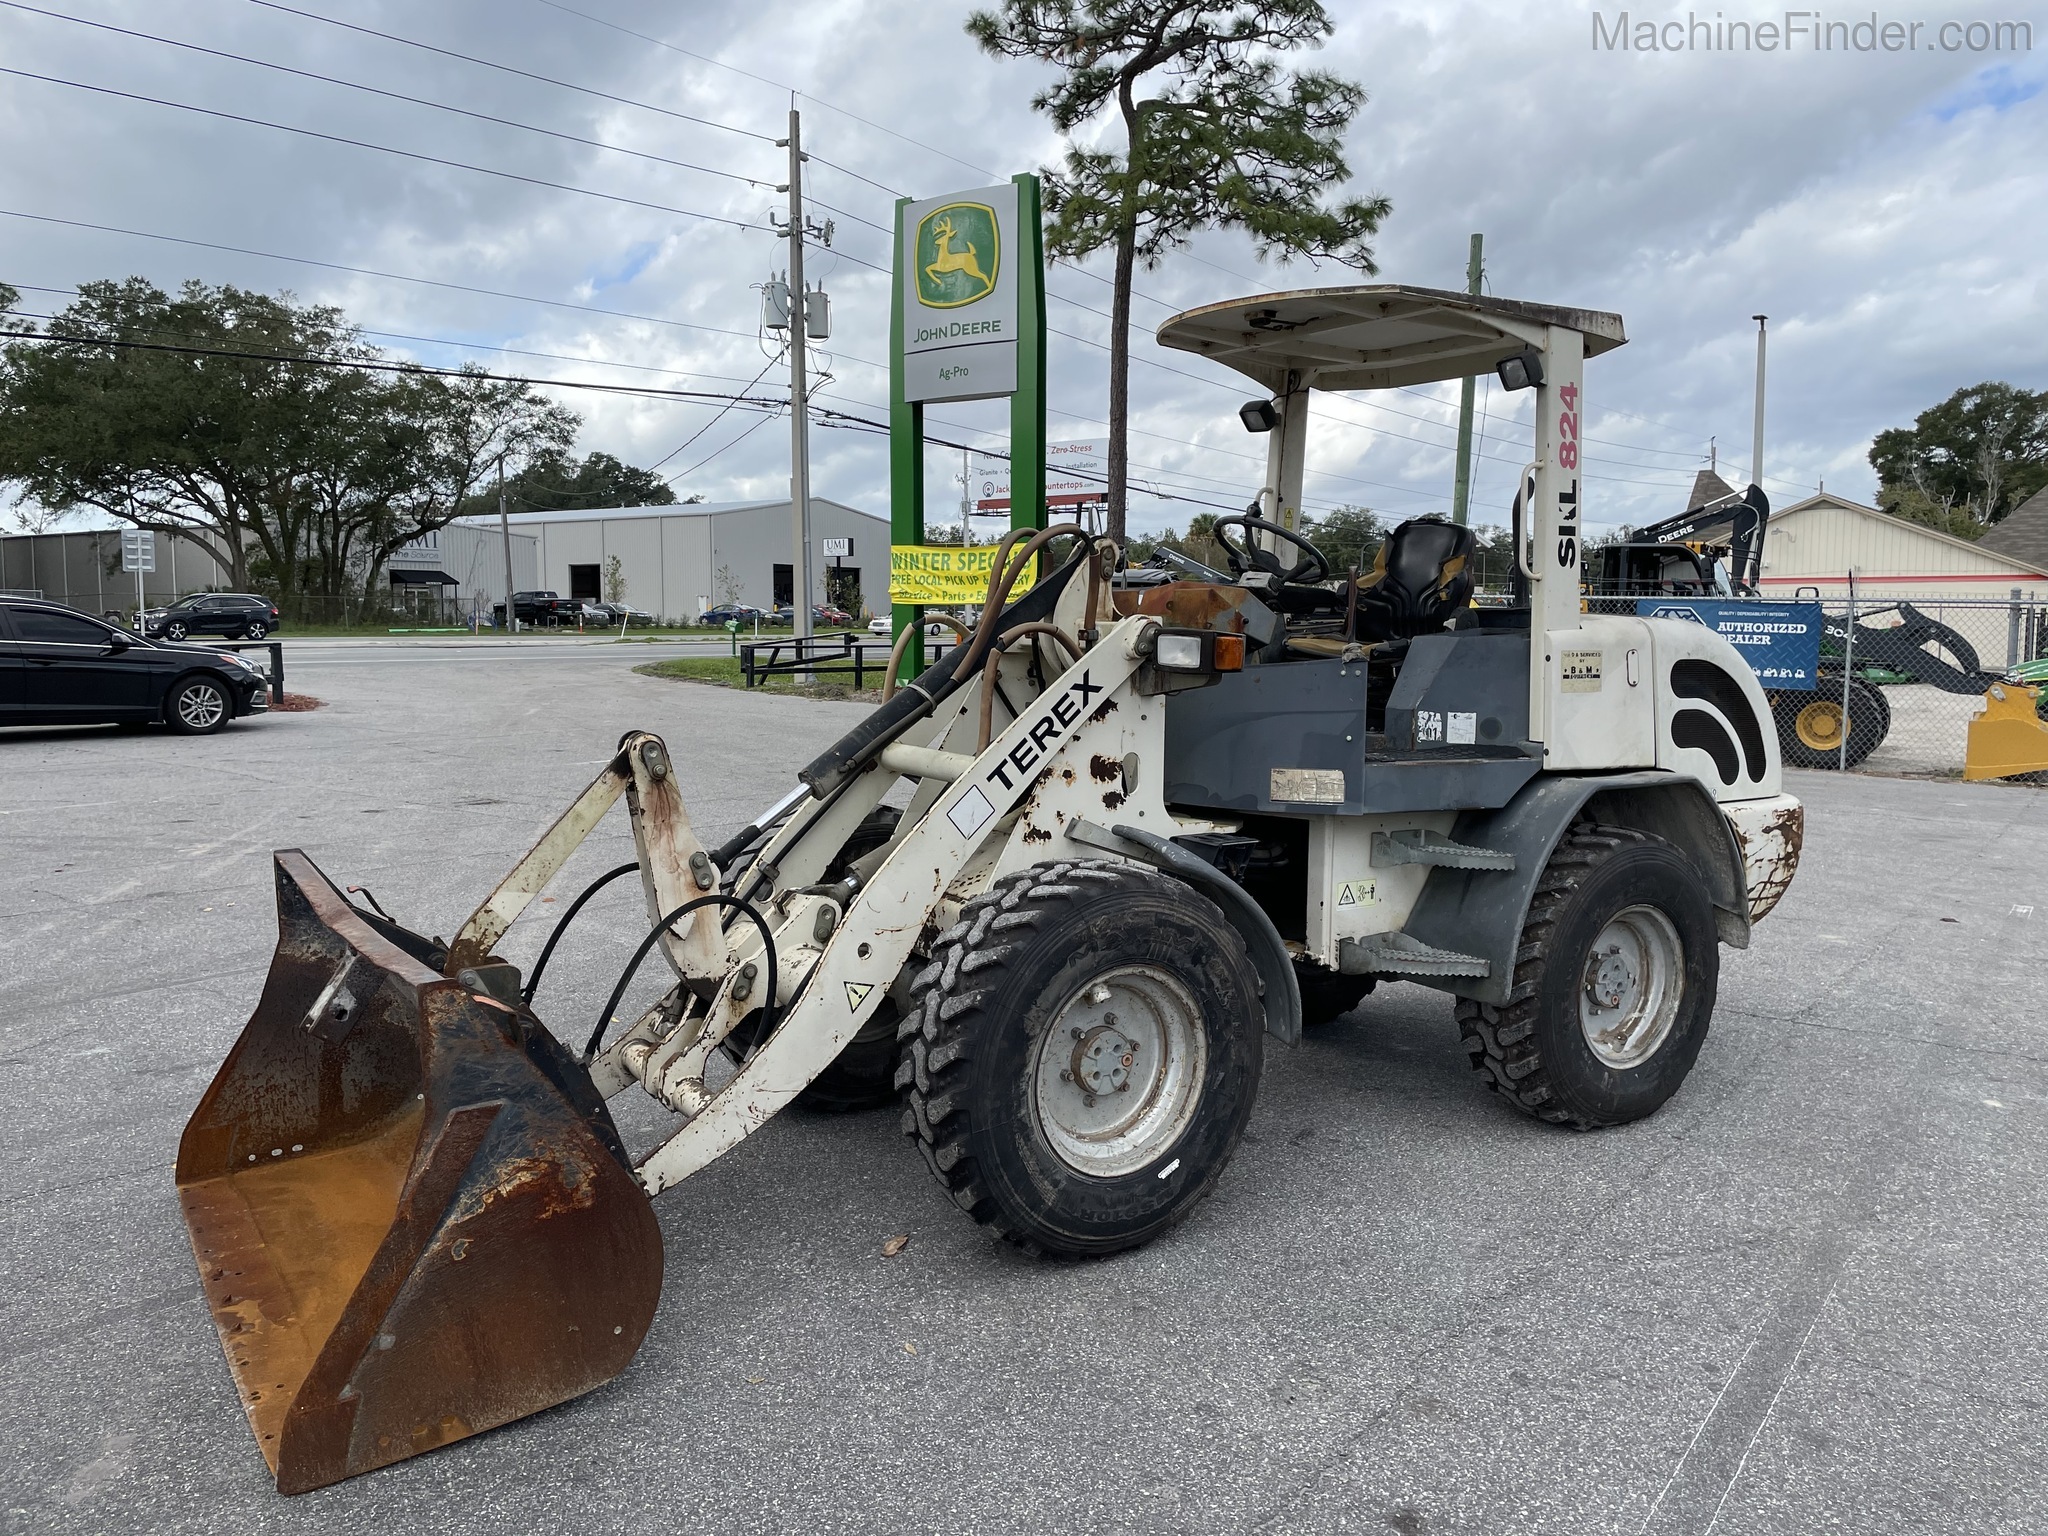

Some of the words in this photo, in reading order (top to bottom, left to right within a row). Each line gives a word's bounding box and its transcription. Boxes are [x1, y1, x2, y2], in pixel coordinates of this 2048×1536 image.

[913, 325, 948, 343] JOHN
[950, 319, 1002, 335] DEERE
[938, 366, 969, 381] Ag-Pro
[1559, 381, 1578, 471] 824
[1051, 446, 1068, 454] Zero
[1069, 444, 1092, 453] Stress
[979, 469, 998, 477] Granite
[1658, 524, 1695, 544] DEERE
[827, 539, 845, 549] UMI
[394, 550, 409, 558] The
[410, 551, 439, 559] Source
[891, 552, 951, 571] WINTER
[957, 552, 1031, 573] SPECA
[891, 573, 912, 585] FREE
[914, 574, 942, 586] LOCAL
[945, 575, 966, 586] PICK
[967, 575, 979, 586] UP
[899, 589, 932, 601] Service
[942, 590, 966, 601] Parts
[1717, 621, 1807, 634] AUTHORIZED
[1571, 666, 1576, 674] B
[1586, 665, 1592, 674] M
[985, 668, 1104, 791] TEREX
